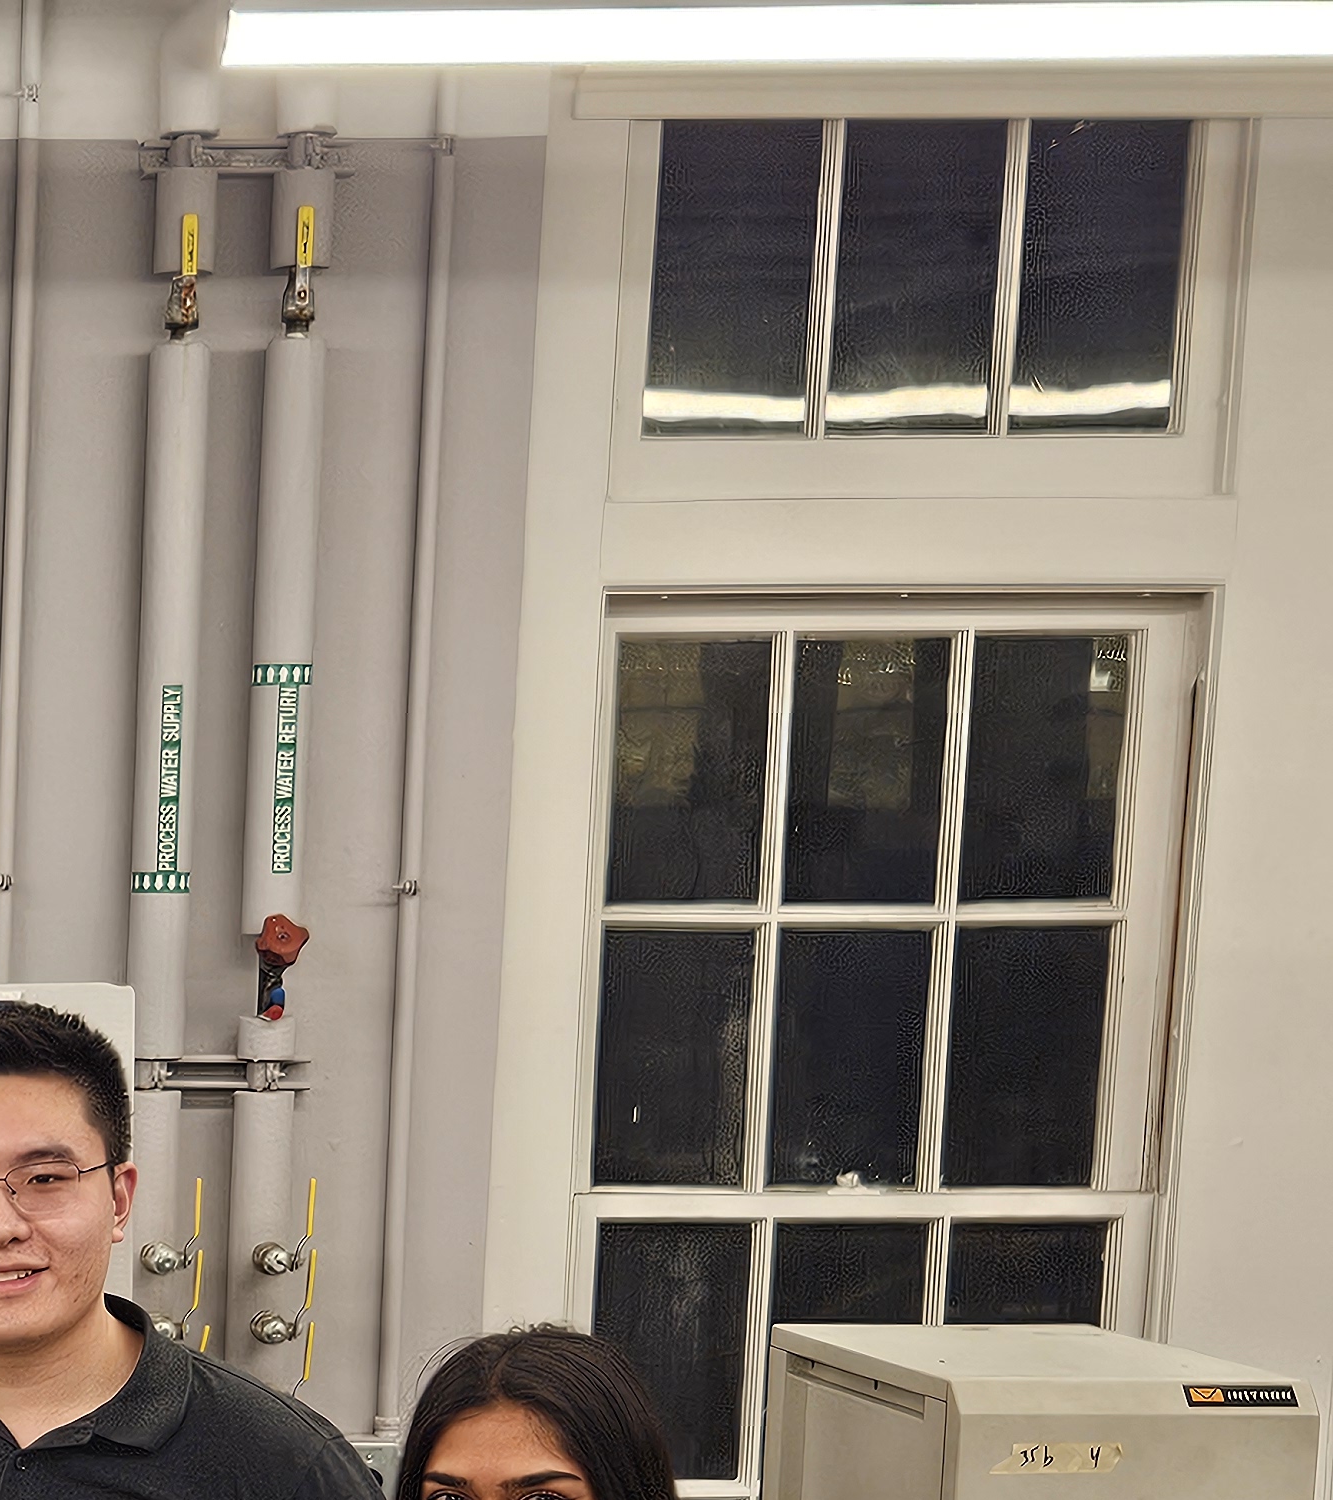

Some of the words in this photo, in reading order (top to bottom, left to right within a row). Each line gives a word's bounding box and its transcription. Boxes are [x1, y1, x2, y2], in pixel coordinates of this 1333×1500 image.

[163, 688, 181, 742] SUPPLY
[279, 687, 297, 743] RETURN
[161, 749, 179, 798] WATER
[276, 751, 294, 799] WATER
[158, 805, 177, 871] PROCESS
[273, 805, 291, 871] PROCESS
